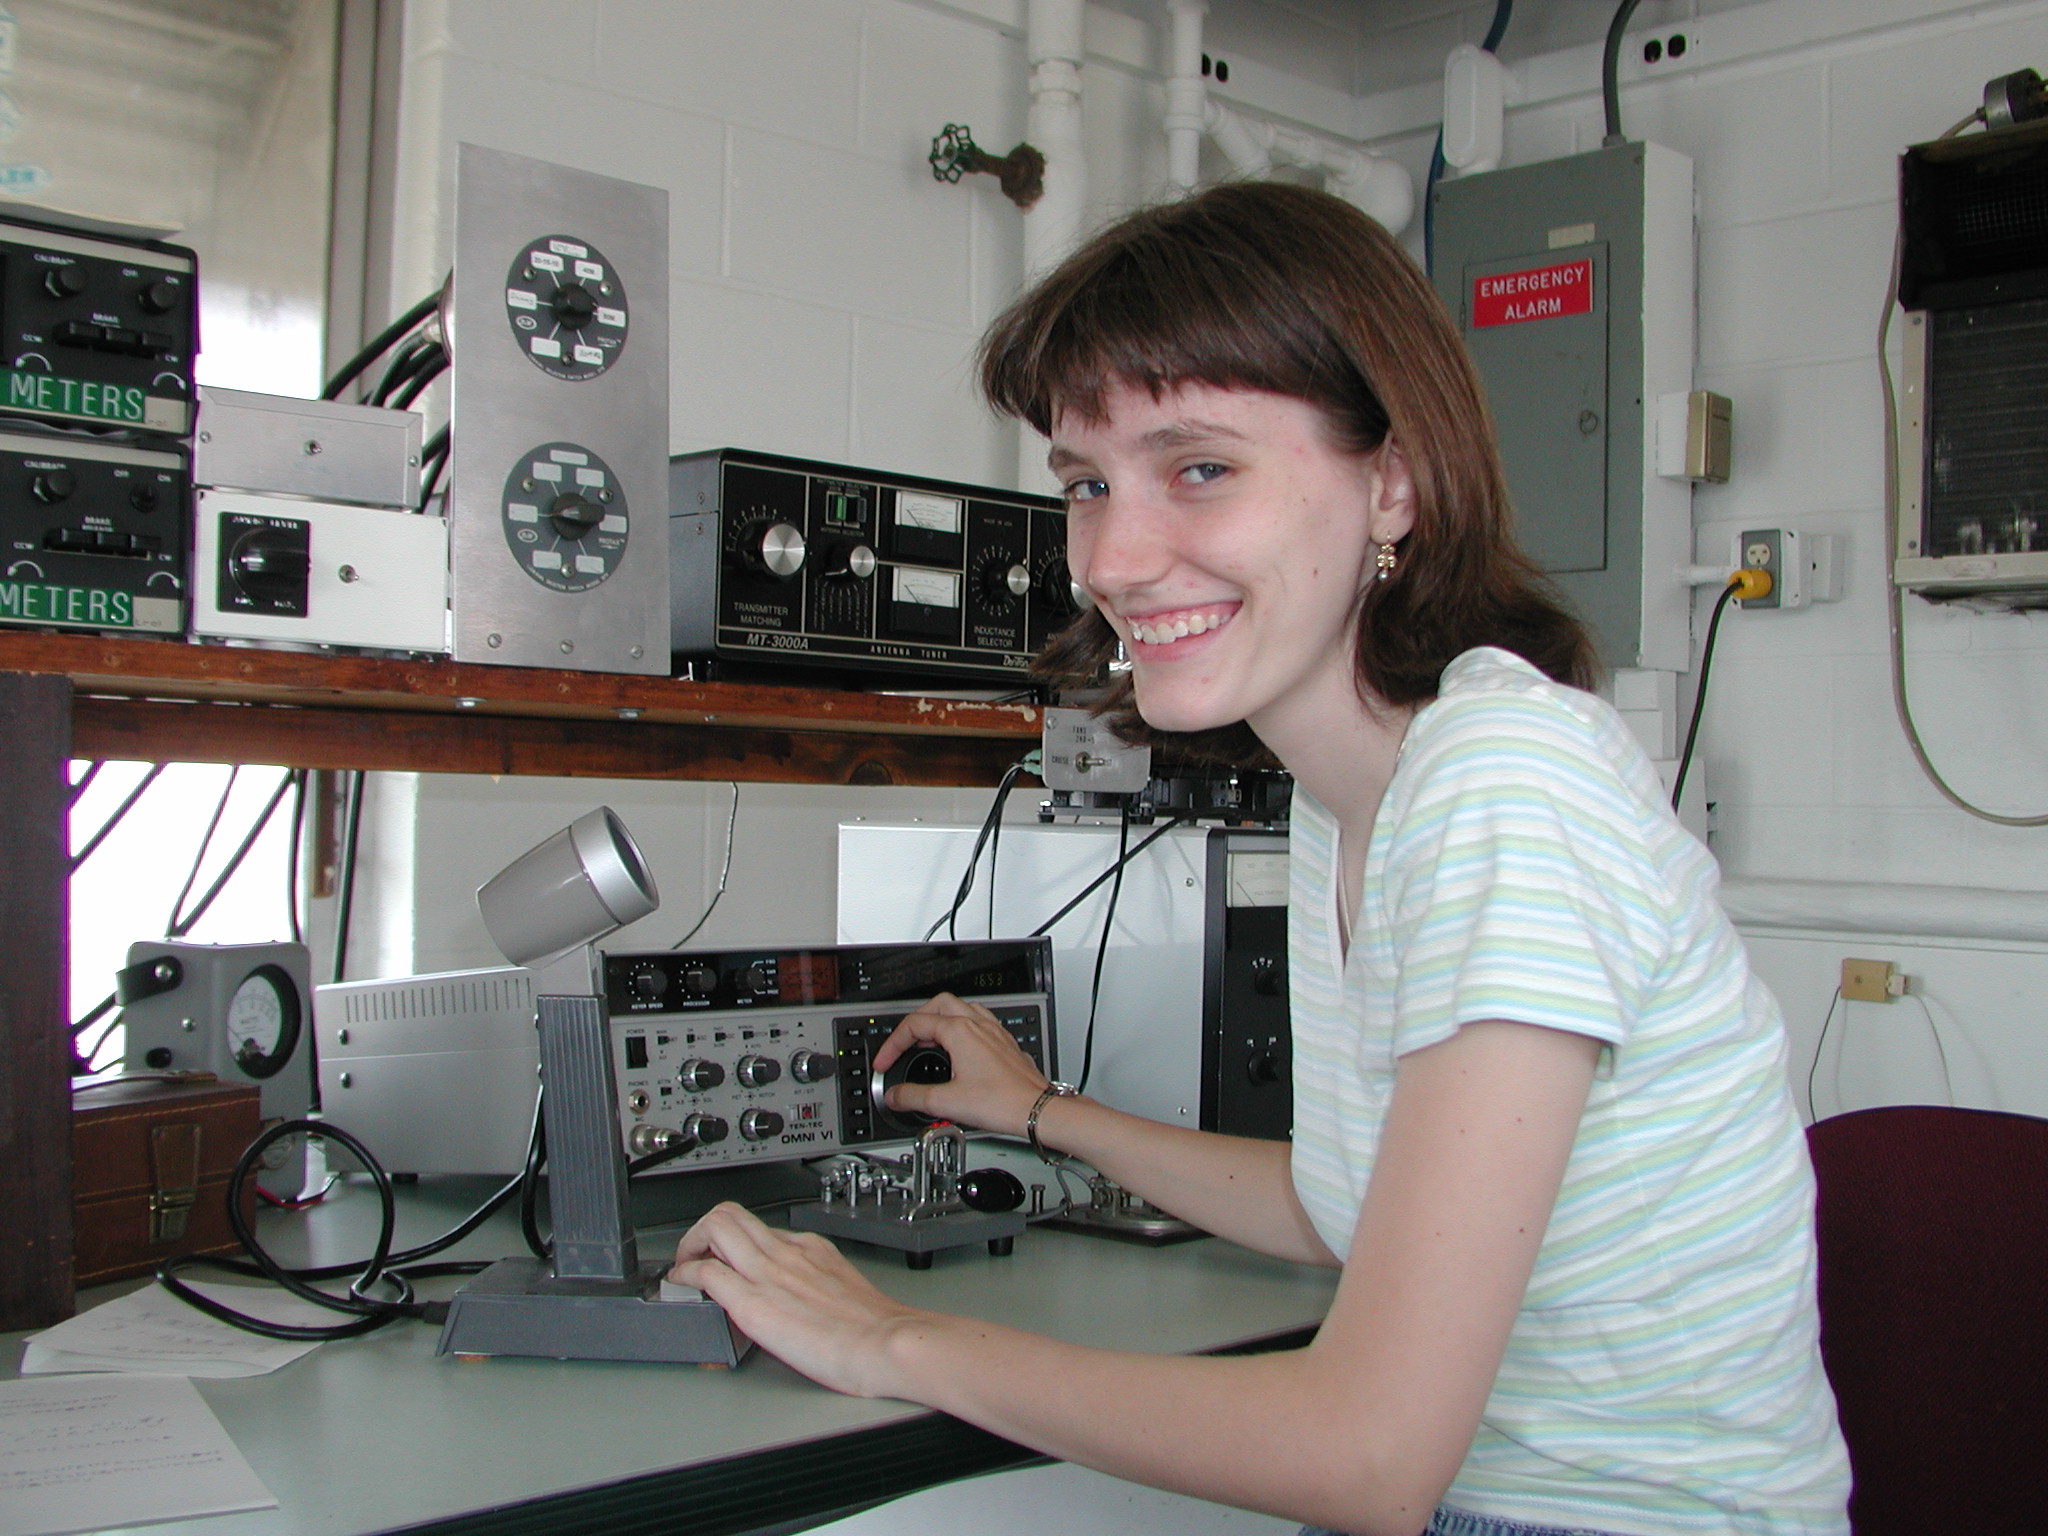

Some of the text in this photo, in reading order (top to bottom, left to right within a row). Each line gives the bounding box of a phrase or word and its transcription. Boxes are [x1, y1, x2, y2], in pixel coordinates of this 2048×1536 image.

[1480, 266, 1585, 298] EMERGENCY
[1504, 297, 1562, 320] ALARM
[9, 372, 143, 420] METERS
[113, 469, 131, 479] OFF
[157, 473, 172, 483] ON
[84, 515, 112, 526] BRAKE
[13, 541, 35, 550] CCW
[158, 554, 173, 562] CW
[0, 582, 130, 624] METERS
[734, 601, 789, 617] TRANSMITTER
[740, 614, 782, 628] MATCHING
[973, 625, 1017, 638] INDUCTANCE
[746, 632, 809, 650] MT-3000A
[977, 637, 1014, 648] SELECTOR
[870, 645, 947, 660] ANTENNA TUNER
[789, 1121, 823, 1130] TEN-TEC
[781, 1130, 833, 1144] OMNI VI
